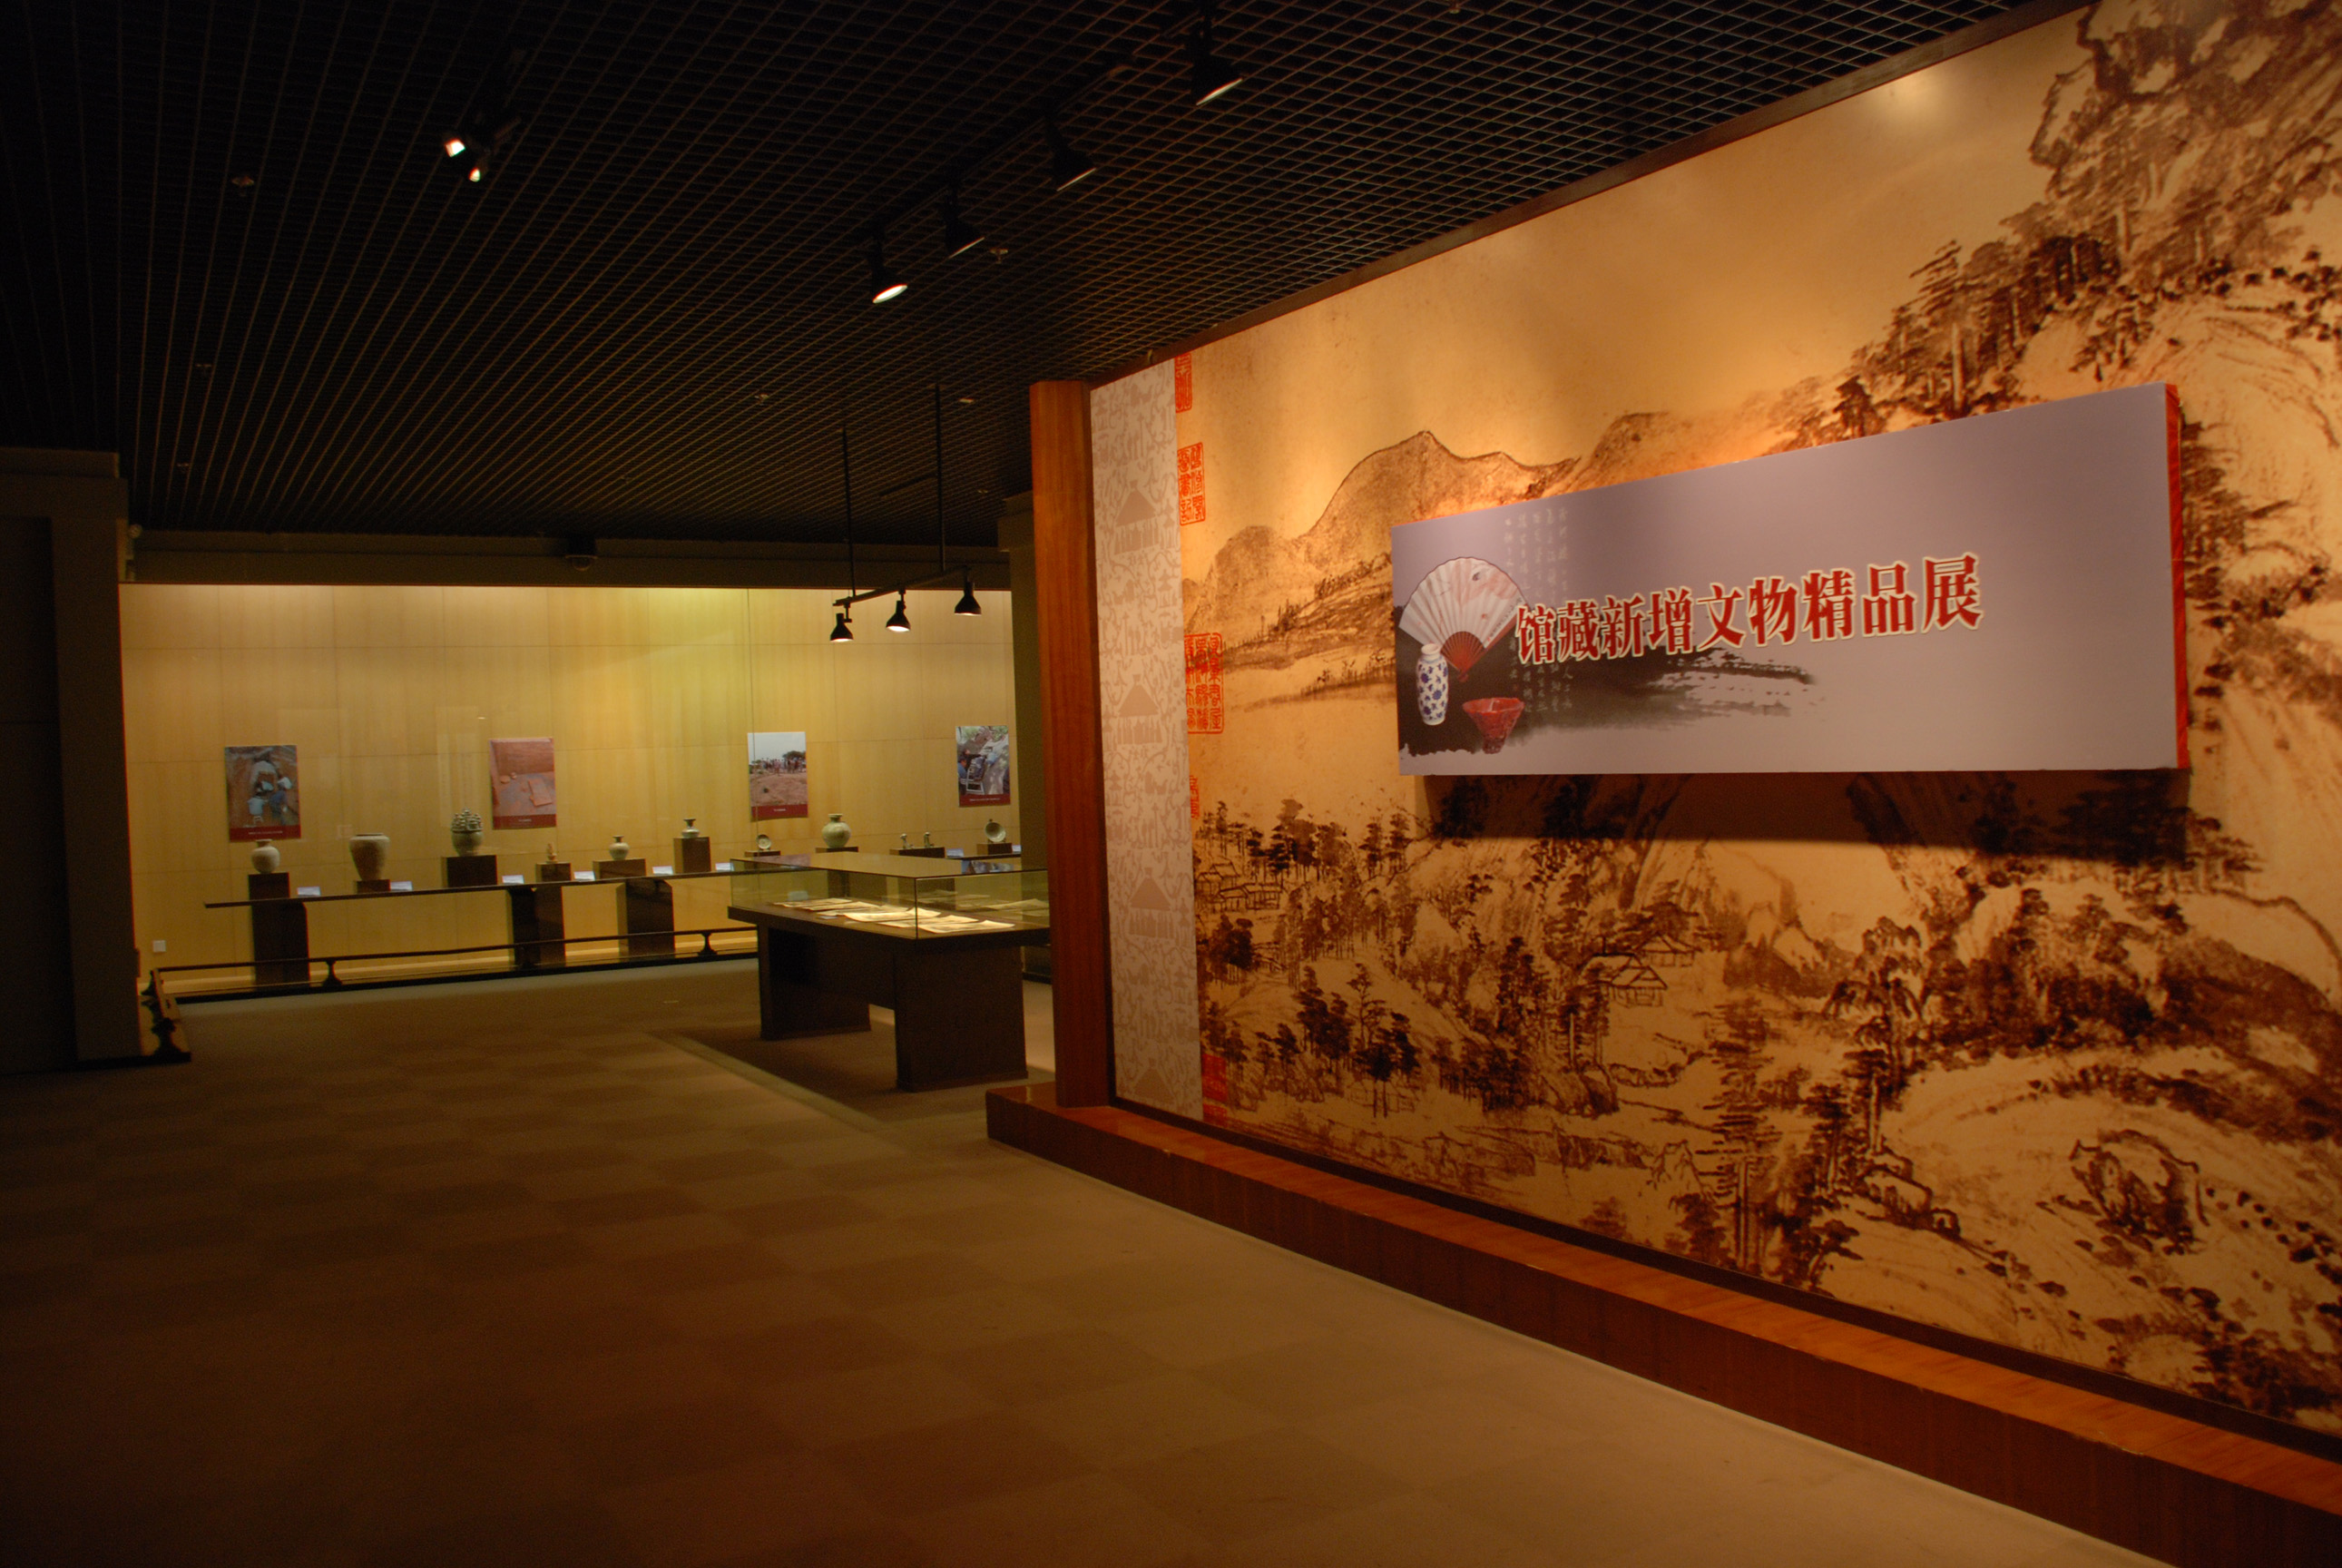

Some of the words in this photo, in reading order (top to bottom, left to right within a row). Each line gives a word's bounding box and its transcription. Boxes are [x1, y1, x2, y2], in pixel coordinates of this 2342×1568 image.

[1514, 553, 1984, 665] 馆藏新增文物精品展
